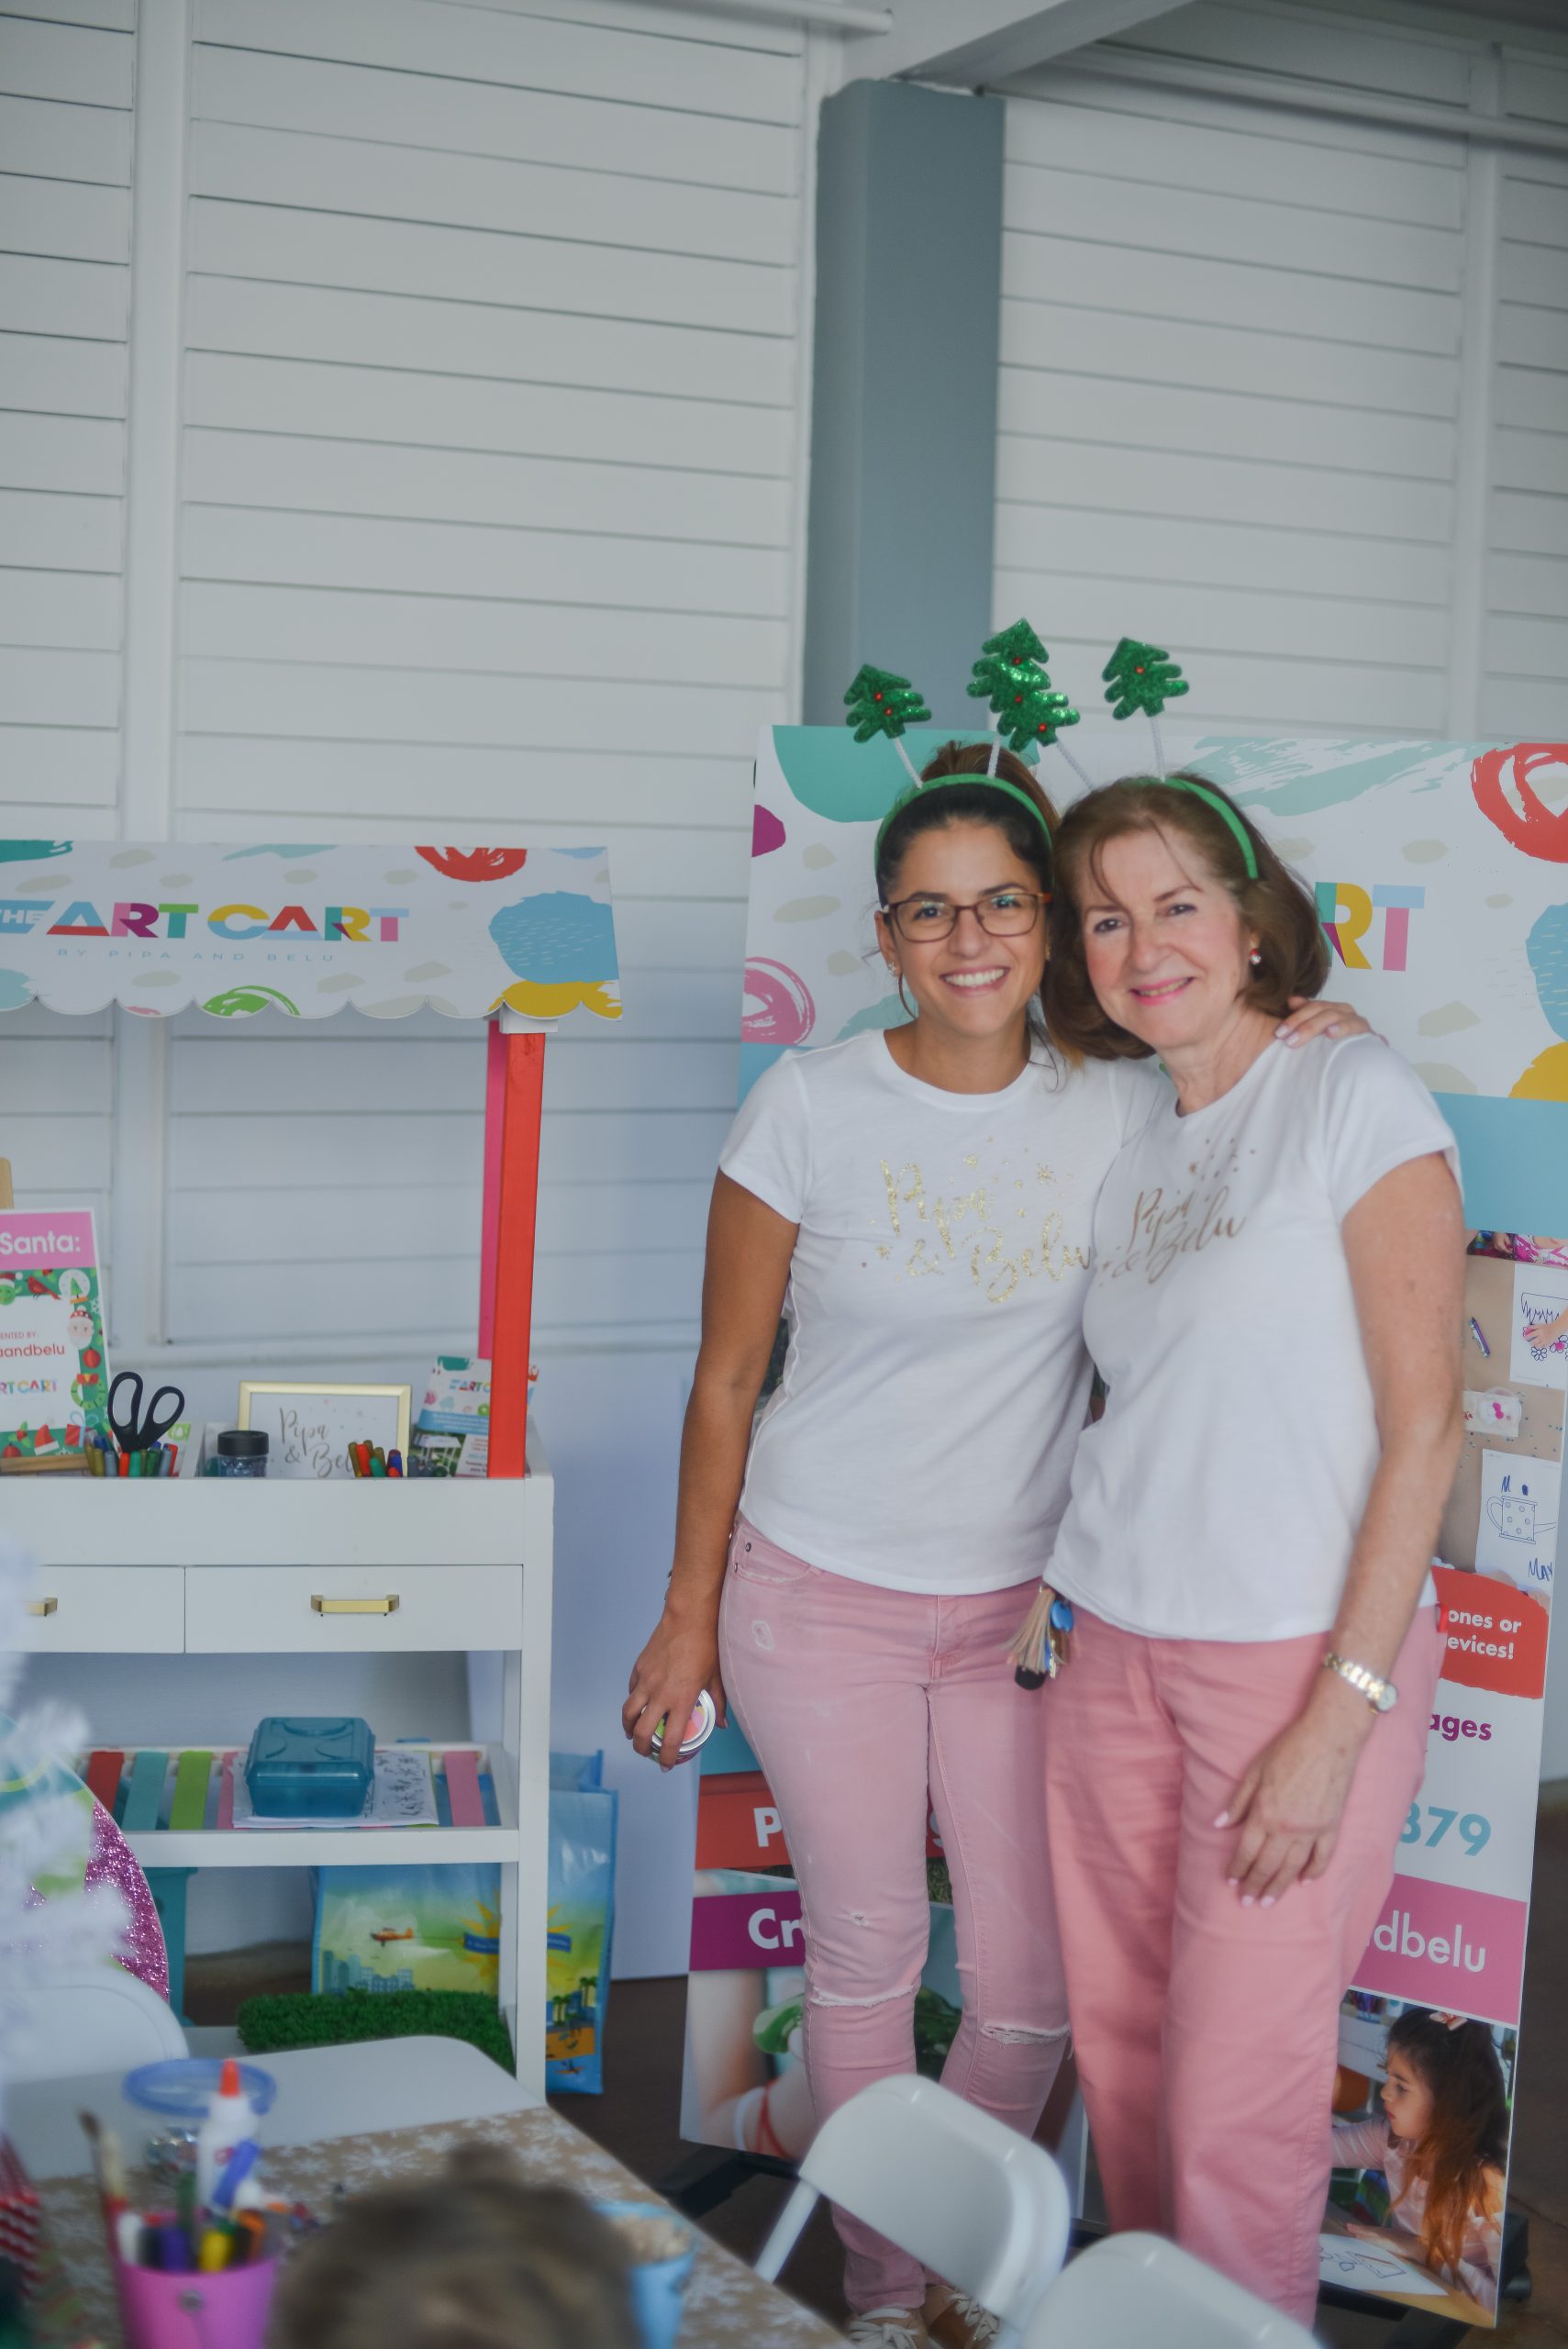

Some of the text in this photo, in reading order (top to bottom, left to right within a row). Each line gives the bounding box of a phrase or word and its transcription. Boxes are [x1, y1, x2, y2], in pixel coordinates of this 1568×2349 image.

[0, 901, 410, 942] HE ART CART
[1315, 882, 1426, 972] RT
[58, 949, 86, 957] BY
[109, 951, 171, 959] PIPA
[193, 952, 244, 961] AND
[0, 1230, 81, 1255] Santa:
[284, 1445, 300, 1464] &
[1448, 1609, 1522, 1633] ones or
[1447, 1634, 1514, 1660] evices!
[1369, 1909, 1486, 1973] dbelu
